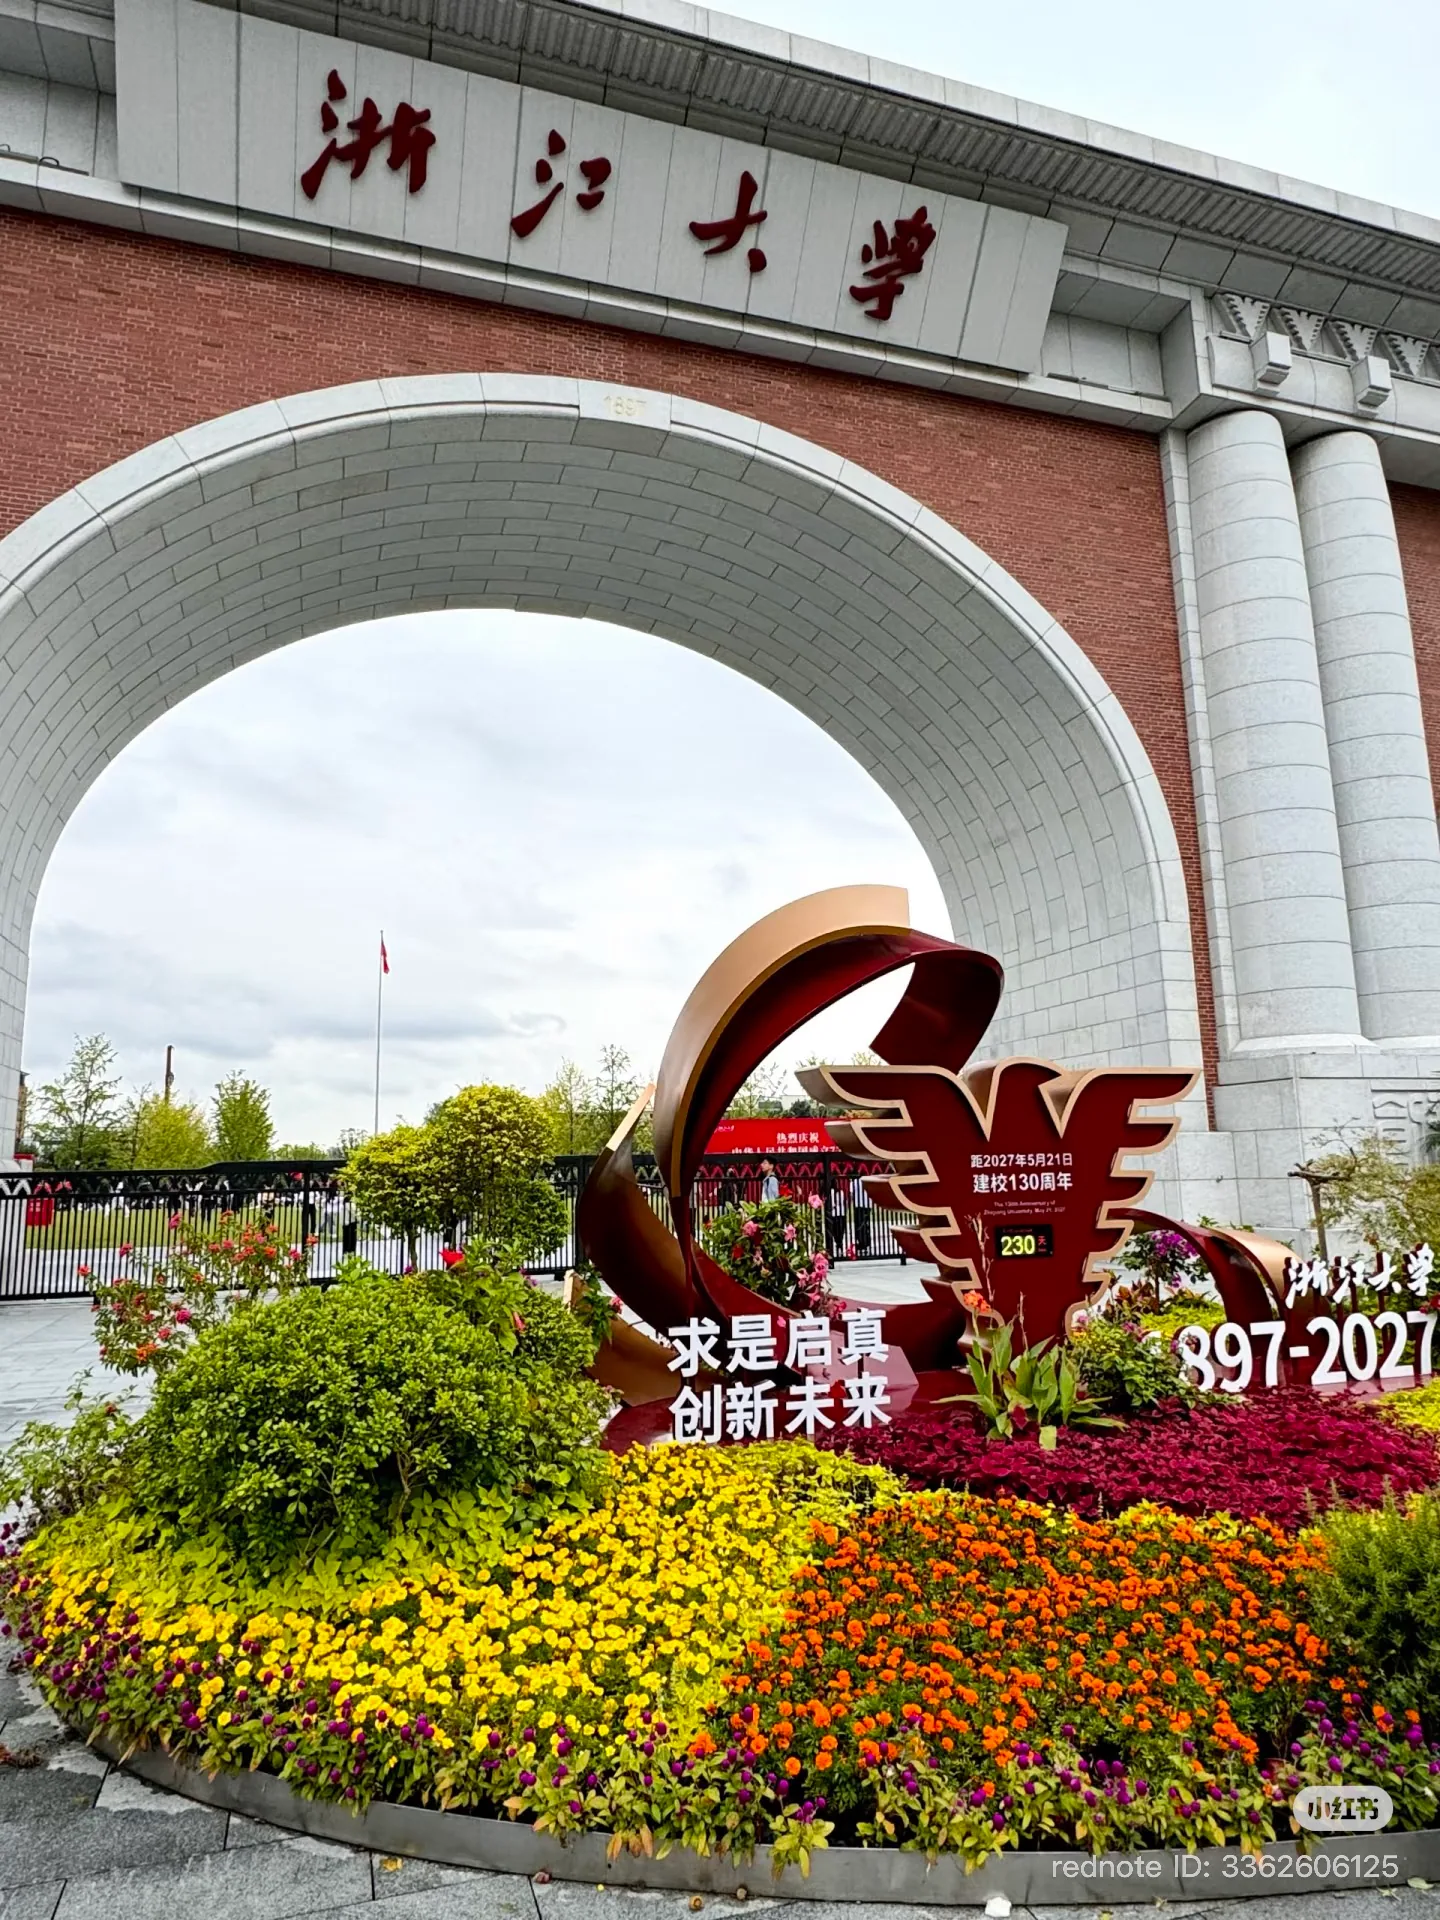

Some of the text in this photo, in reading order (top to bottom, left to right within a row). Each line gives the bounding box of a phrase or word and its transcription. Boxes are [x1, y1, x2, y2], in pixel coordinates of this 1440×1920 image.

[301, 69, 936, 320] 浙江大学
[776, 1132, 819, 1144] 热烈庆祝
[971, 1153, 1073, 1168] 距2027年5月21日
[973, 1172, 1073, 1193] 建校130周年
[1001, 1235, 1047, 1256] 230 天
[1284, 1242, 1435, 1309] 浙江大学
[667, 1308, 889, 1377] 求是启真
[1142, 1311, 1438, 1393] 897-2027
[669, 1372, 892, 1444] 创新未来
